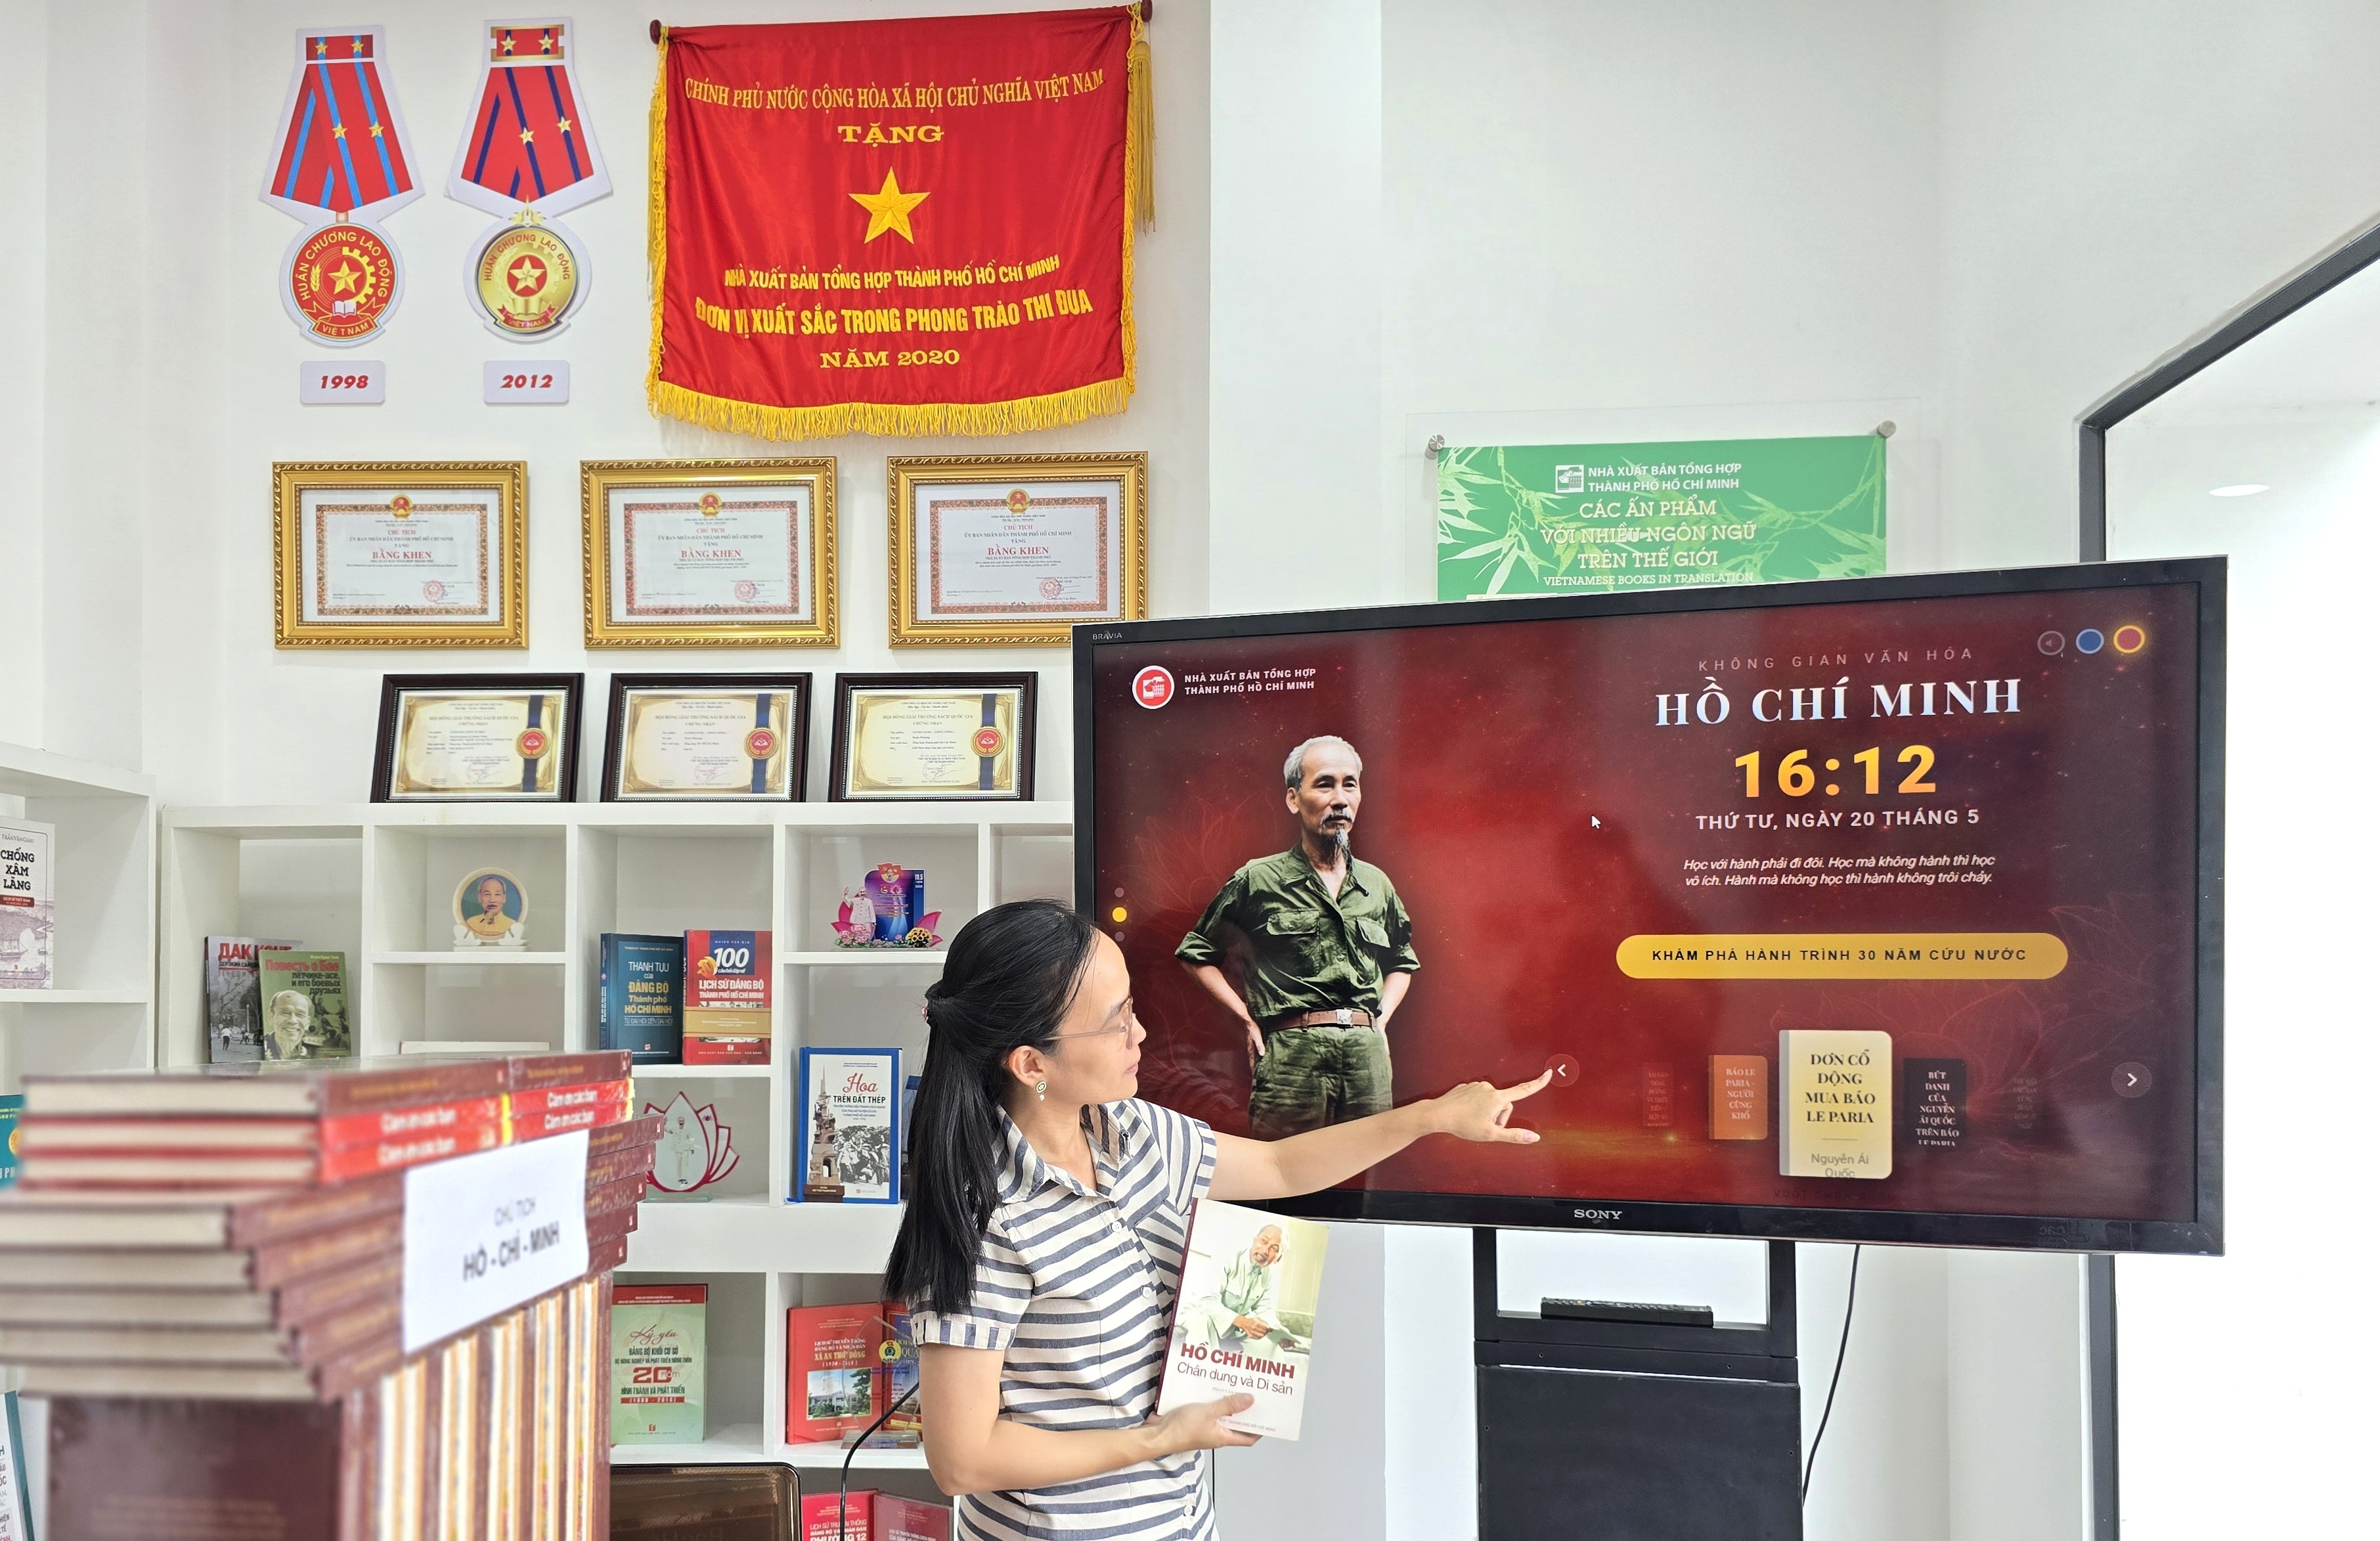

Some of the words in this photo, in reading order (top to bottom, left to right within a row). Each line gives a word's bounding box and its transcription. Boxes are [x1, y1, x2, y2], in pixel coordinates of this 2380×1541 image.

[686, 78, 730, 105] CHÍNH
[733, 82, 763, 108] PHỦ
[766, 85, 808, 109] NƯỚC
[812, 83, 854, 114] CỘNG
[857, 82, 889, 108] HÒA
[892, 82, 912, 108] XÃ
[915, 82, 942, 111] HỘI
[948, 78, 979, 106] CHỦ
[982, 77, 1032, 104] NGHĨA
[1034, 74, 1069, 101] VIỆT
[1072, 69, 1103, 95] NAM
[838, 122, 944, 147] TẶNG
[296, 262, 311, 300] HUÂN
[305, 231, 357, 259] CHƯƠNG
[360, 236, 381, 256] LAO
[378, 259, 392, 297] ĐỘNG
[725, 264, 746, 286] NHÀ
[749, 266, 787, 289] XUẤT
[790, 265, 818, 290] BẢN
[822, 264, 860, 289] TỔNG
[864, 271, 892, 291] HỢP
[894, 266, 940, 287] THÀNH
[944, 261, 973, 286] PHỐ
[975, 259, 996, 284] HỒ
[999, 261, 1023, 282] CHÍ
[1026, 255, 1059, 279] MINH
[695, 297, 730, 332] ĐƠN
[734, 309, 749, 338] VỊ
[751, 303, 795, 334] XUẤT
[801, 303, 837, 334] SẮC
[841, 308, 901, 334] TRONG
[906, 308, 968, 332] PHONG
[972, 301, 1020, 329] TRÀO
[1023, 293, 1054, 320] THI
[1055, 290, 1093, 315] ĐUA
[820, 349, 889, 368] NĂM
[898, 350, 959, 366] 2020
[320, 375, 368, 389] 1998
[500, 374, 553, 389] 2012
[1588, 464, 1614, 477] NHÀ
[1618, 464, 1648, 477] XUẤT
[1651, 463, 1678, 477] BẢN
[1680, 462, 1713, 477] TỔNG
[1715, 463, 1742, 477] HỢP
[1588, 479, 1629, 492] THÀNH
[1632, 479, 1660, 491] PHỐ
[1662, 478, 1681, 490] HỒ
[1683, 478, 1704, 490] CHÍ
[1706, 479, 1739, 489] MINH
[1579, 499, 1620, 518] CÁC
[1625, 496, 1654, 517] ẤN
[1660, 495, 1716, 516] PHẨM
[1541, 527, 1577, 544] VỚI
[1579, 523, 1642, 544] NHIỀU
[1646, 521, 1708, 542] NGÔN
[1711, 521, 1757, 542] NGỮ
[988, 544, 1016, 555] BẰNG
[1020, 547, 1049, 555] KHEN
[1578, 551, 1627, 569] TRÊN
[1631, 550, 1668, 567] THẾ
[1674, 549, 1718, 567] GIỚI
[1543, 575, 1615, 587] VIETNAMESE
[1618, 575, 1656, 584] BOOKS
[1659, 575, 1671, 583] IN
[1674, 572, 1755, 586] TRANSLATION
[1093, 631, 1122, 640] BRAVIA
[1699, 657, 1773, 671] KHÔNG
[1792, 655, 1846, 666] GIAN
[1864, 650, 1907, 663] VĂN
[1928, 647, 1971, 661] HÓA
[1185, 672, 1206, 682] NHÀ
[1210, 670, 1236, 682] XUẤT
[1239, 670, 1260, 682] BẢN
[1264, 668, 1291, 682] TỔNG
[1295, 668, 1315, 678] HỢP
[1185, 685, 1219, 695] THÀNH
[1223, 682, 1244, 693] PHỐ
[1248, 682, 1262, 691] HỒ
[1266, 681, 1283, 691] CHÍ
[1656, 676, 1729, 726] HỒ
[1753, 676, 1849, 722] CHÍ
[1871, 679, 2020, 717] MINH
[1736, 745, 1935, 797] 16:12
[1696, 812, 1740, 829] THỨ
[1745, 814, 1777, 830] TƯ,
[1786, 810, 1842, 827] NGÀY
[1851, 812, 1874, 826] 20
[1882, 808, 1957, 828] THÁNG
[1968, 810, 1979, 823] 5
[1, 847, 35, 863] CHỐNG
[1684, 859, 1708, 871] Học
[1711, 859, 1729, 869] với
[1729, 858, 1759, 869] hành
[1761, 857, 1788, 871] phải
[1790, 857, 1801, 868] đi
[1803, 857, 1824, 868] đôi.
[1828, 857, 1853, 869] Học
[1855, 857, 1876, 867] mà
[1878, 856, 1916, 869] không
[1919, 856, 1950, 866] hành
[1953, 855, 1969, 865] thì
[1972, 855, 1995, 867] học
[5, 863, 29, 877] XÂM
[3, 877, 31, 890] LĂNG
[1686, 876, 1700, 886] vô
[1702, 875, 1721, 886] ích.
[1725, 875, 1756, 885] Hành
[1758, 875, 1778, 884] mà
[1780, 874, 1818, 886] không
[1820, 874, 1843, 886] học
[1845, 873, 1861, 884] thì
[1863, 873, 1894, 883] hành
[1897, 873, 1935, 885] không
[1938, 872, 1959, 882] trôi
[1961, 871, 1991, 884] chảy.
[218, 943, 252, 961] ДАК
[715, 948, 749, 968] 100
[1653, 949, 1697, 960] KHÁM
[1706, 948, 1737, 960] PHÁ
[1746, 948, 1790, 960] HÀNH
[1800, 948, 1849, 960] TRÌNH
[1859, 951, 1875, 960] 30
[1885, 948, 1920, 960] NĂM
[1929, 947, 1965, 960] CỨU
[1975, 947, 2025, 960] NƯỚC
[843, 1073, 878, 1093] Hoa
[833, 1094, 851, 1103] TRÊN
[852, 1093, 866, 1103] ĐẤT
[868, 1095, 886, 1104] THÉP
[1806, 1093, 1838, 1103] MUA
[1844, 1091, 1875, 1104] BÁO
[1807, 1112, 1824, 1121] LE
[1830, 1112, 1873, 1123] PARIA
[1574, 1209, 1622, 1219] SONY
[1181, 1342, 1208, 1360] HỒ
[1211, 1350, 1243, 1368] CHÍ
[1246, 1357, 1294, 1379] MINH
[633, 1366, 672, 1383] 20
[1178, 1362, 1206, 1378] Chân
[1210, 1369, 1237, 1386] dung
[1241, 1376, 1253, 1387] và
[1257, 1378, 1269, 1390] Di
[1272, 1381, 1292, 1395] sản
